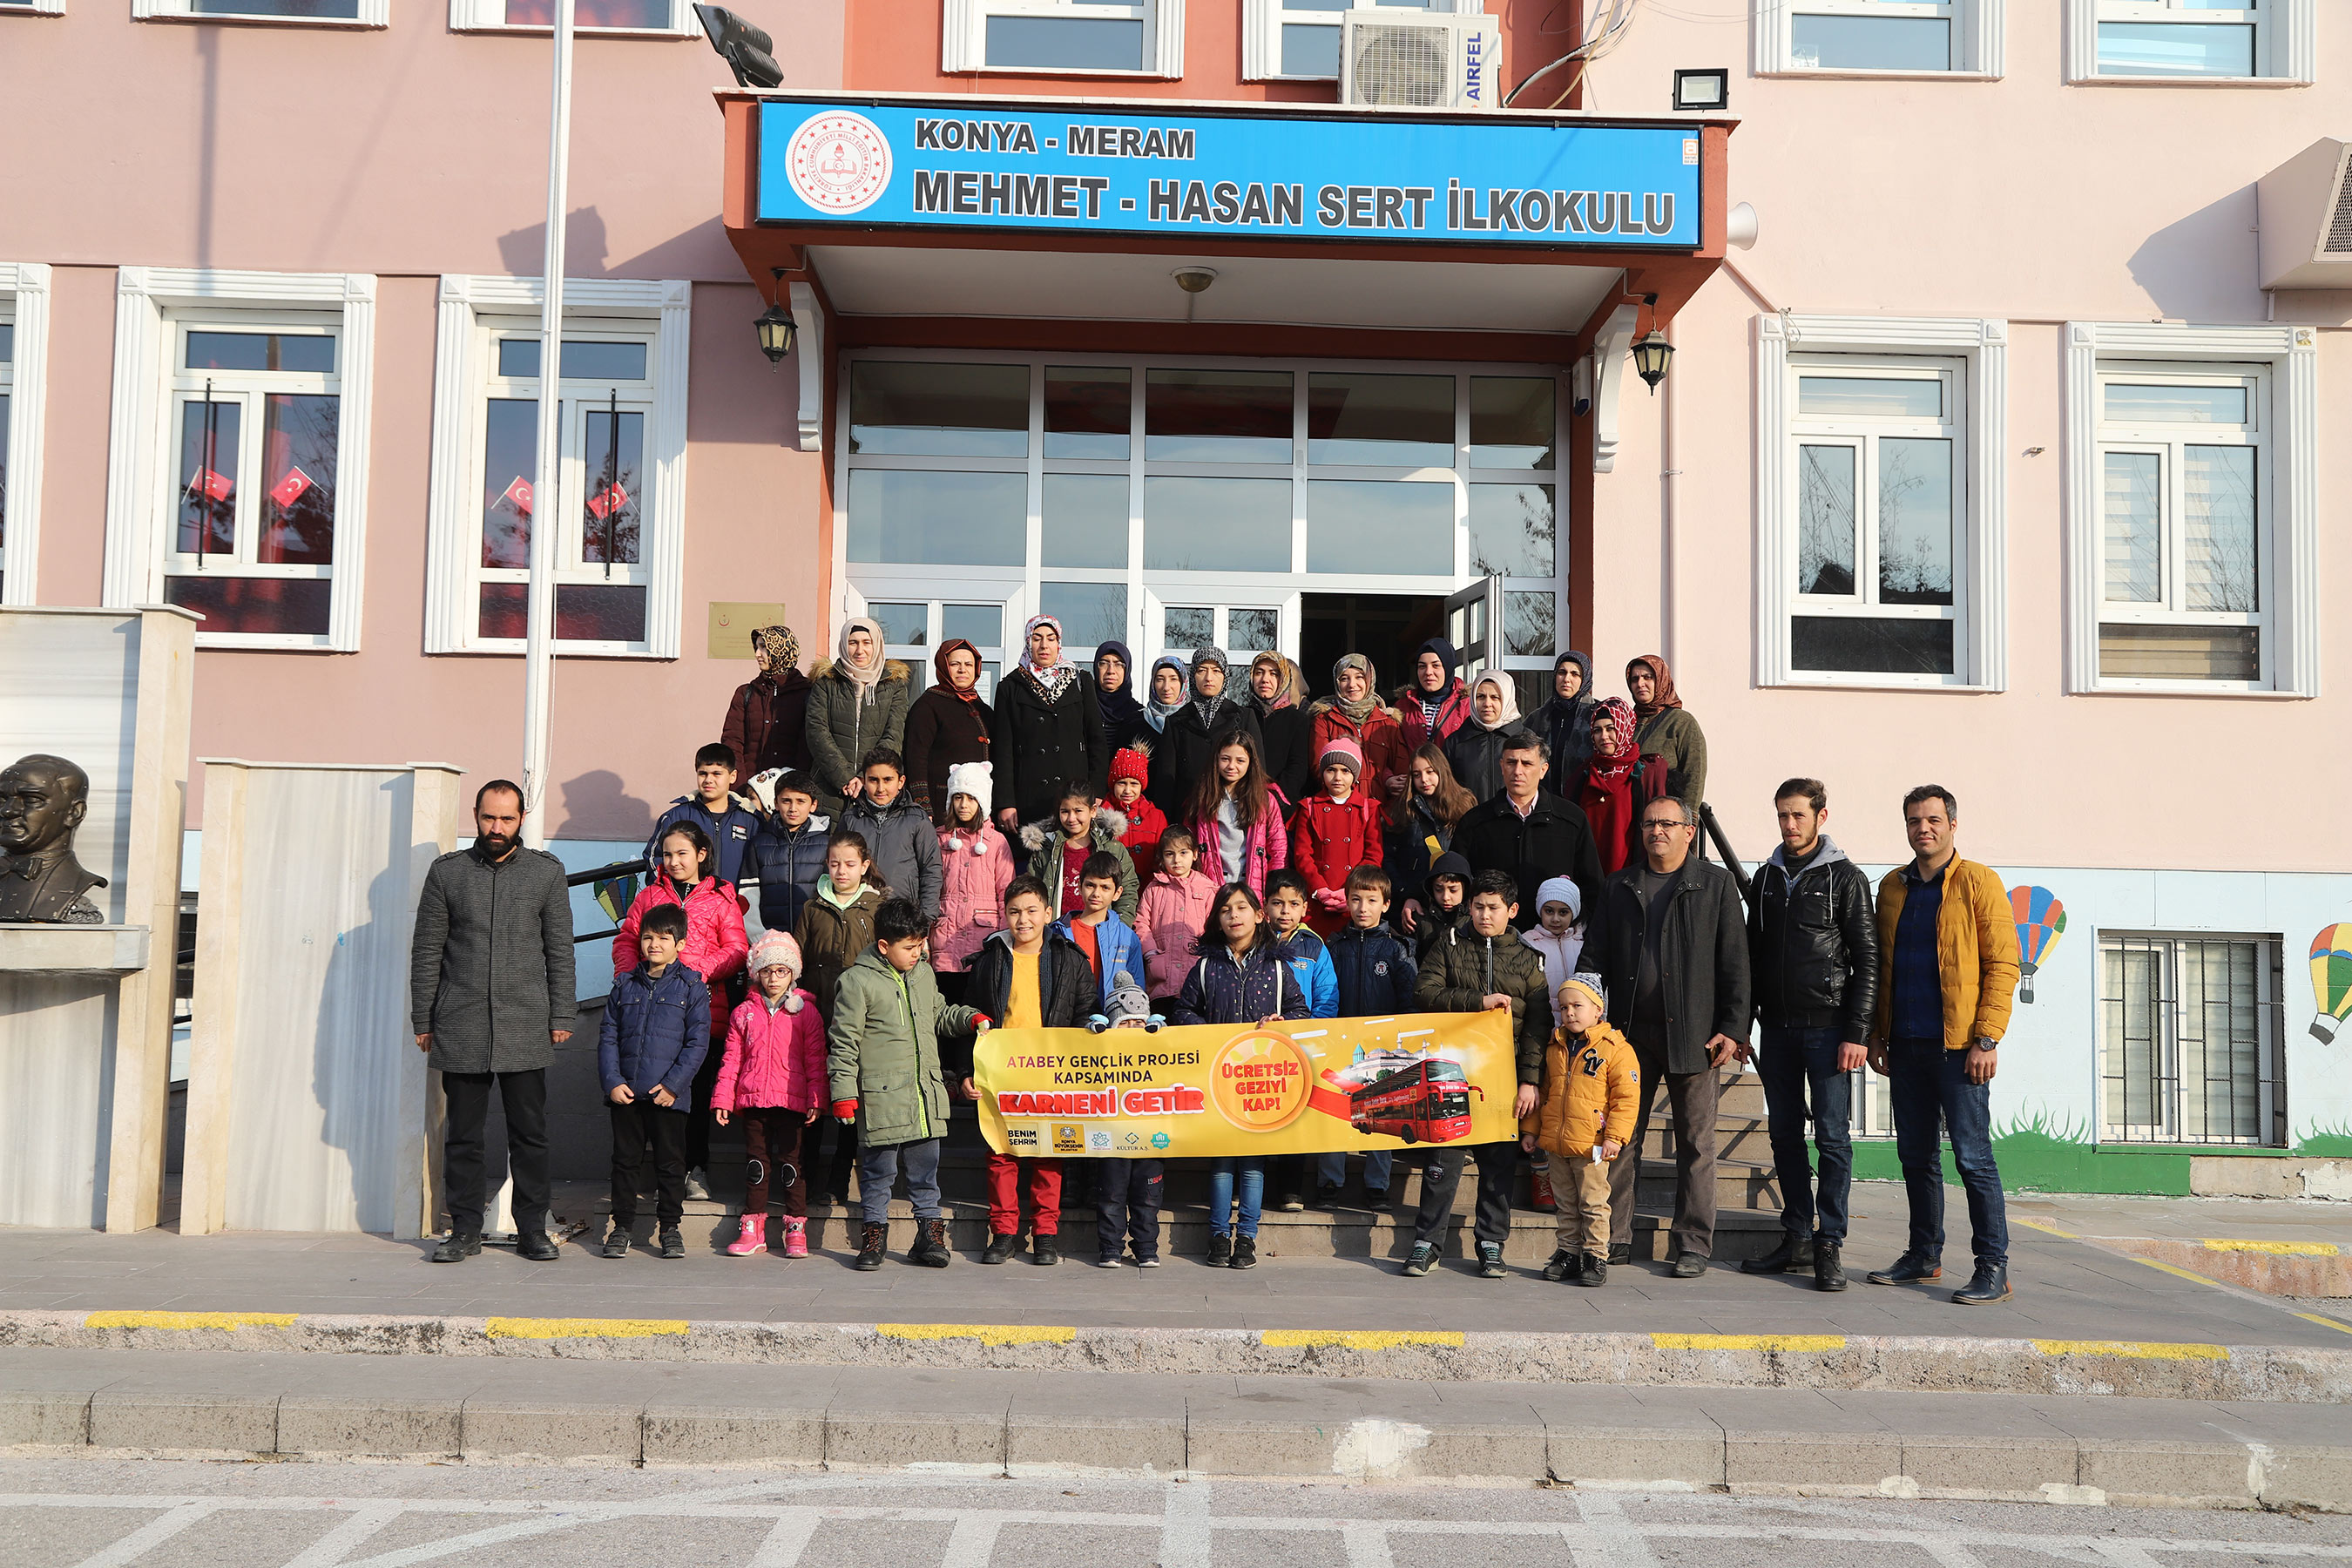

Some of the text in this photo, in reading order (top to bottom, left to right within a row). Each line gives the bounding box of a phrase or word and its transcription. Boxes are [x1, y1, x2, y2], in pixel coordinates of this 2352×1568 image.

[1467, 32, 1481, 101] AIRFEL
[915, 118, 1038, 154] KONYA
[1066, 124, 1196, 160] MERAM
[913, 169, 1110, 220] MEHMET
[1148, 179, 1303, 226] HASAN
[1316, 184, 1435, 230] SERT
[1446, 177, 1675, 236] İLKOKULU
[1006, 1050, 1200, 1070] ATABEY GENÇLİK PROJESİ
[1221, 1060, 1299, 1078] ÜCRETSİZ
[1054, 1070, 1153, 1085] KAPSAMINDA
[998, 1084, 1205, 1116] KARNENİ GETİR
[1243, 1097, 1281, 1112] KAP!
